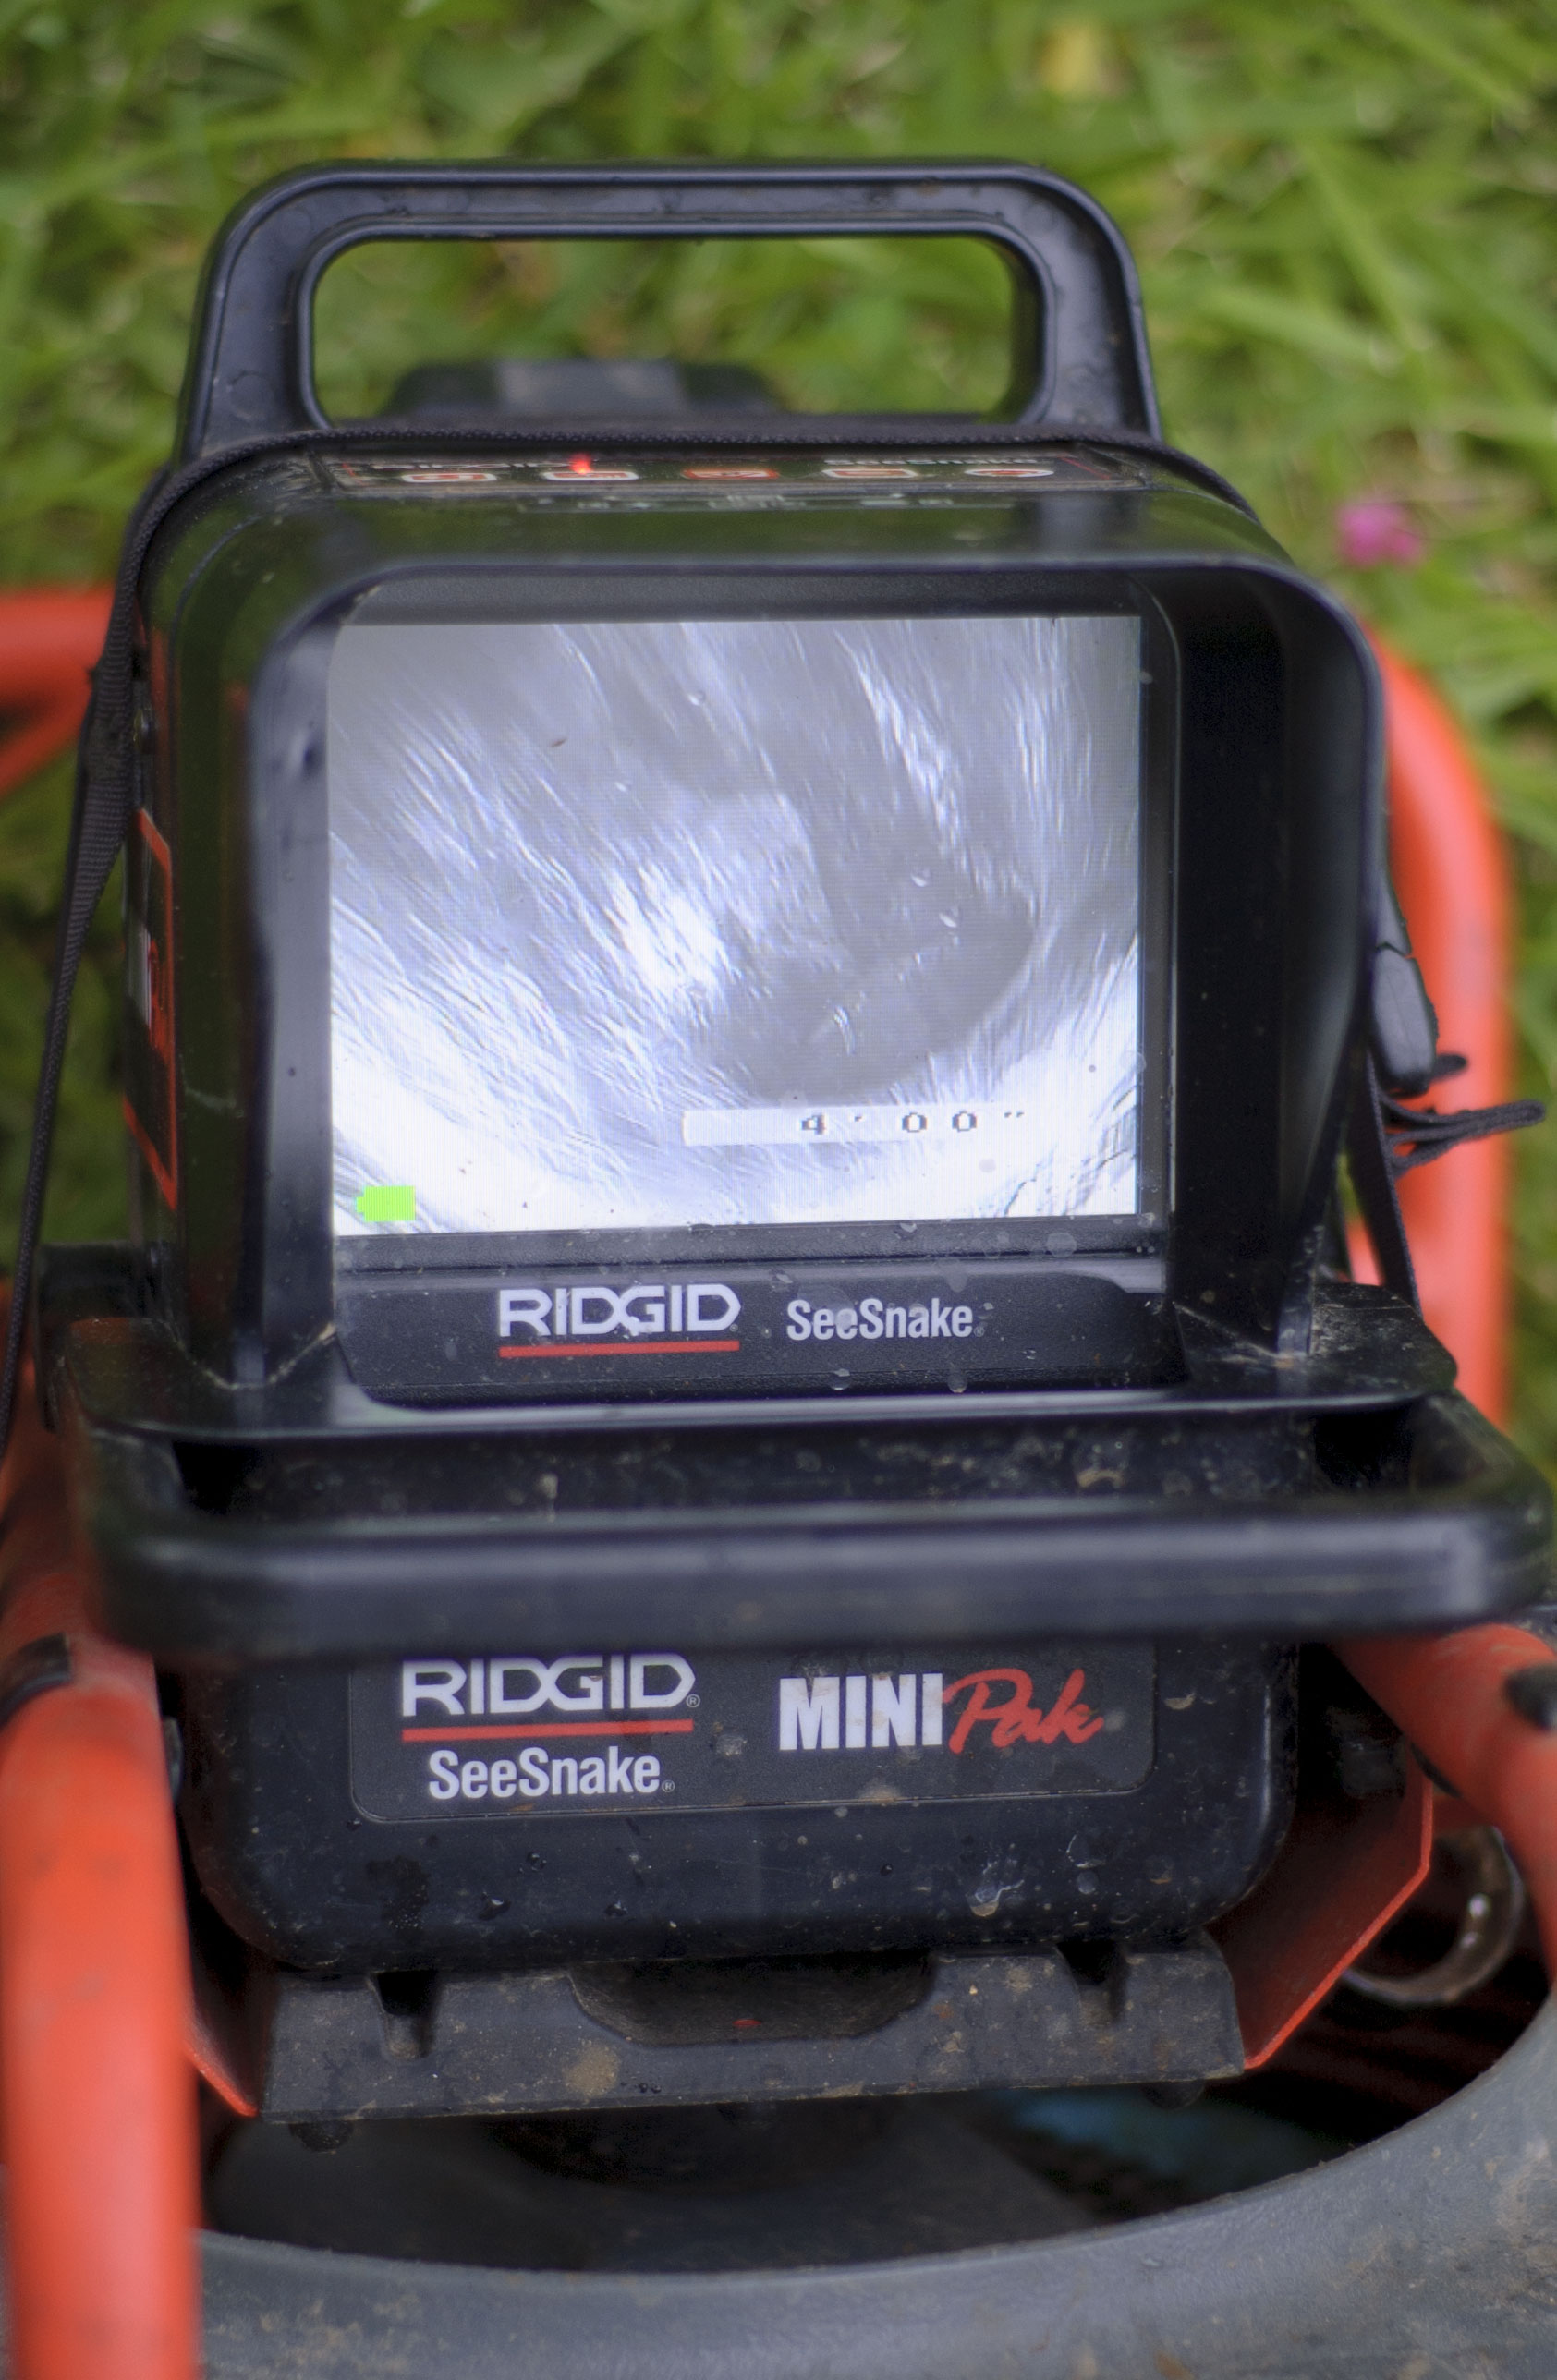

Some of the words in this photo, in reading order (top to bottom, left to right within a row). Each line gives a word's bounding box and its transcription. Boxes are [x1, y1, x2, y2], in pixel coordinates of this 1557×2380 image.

[499, 1283, 740, 1337] RIDGID
[785, 1297, 974, 1341] SeeSnake
[401, 1654, 697, 1717] RIDGID
[779, 1672, 943, 1751] MINI
[940, 1667, 1105, 1755] Pak
[428, 1745, 662, 1801] SeeSnake
